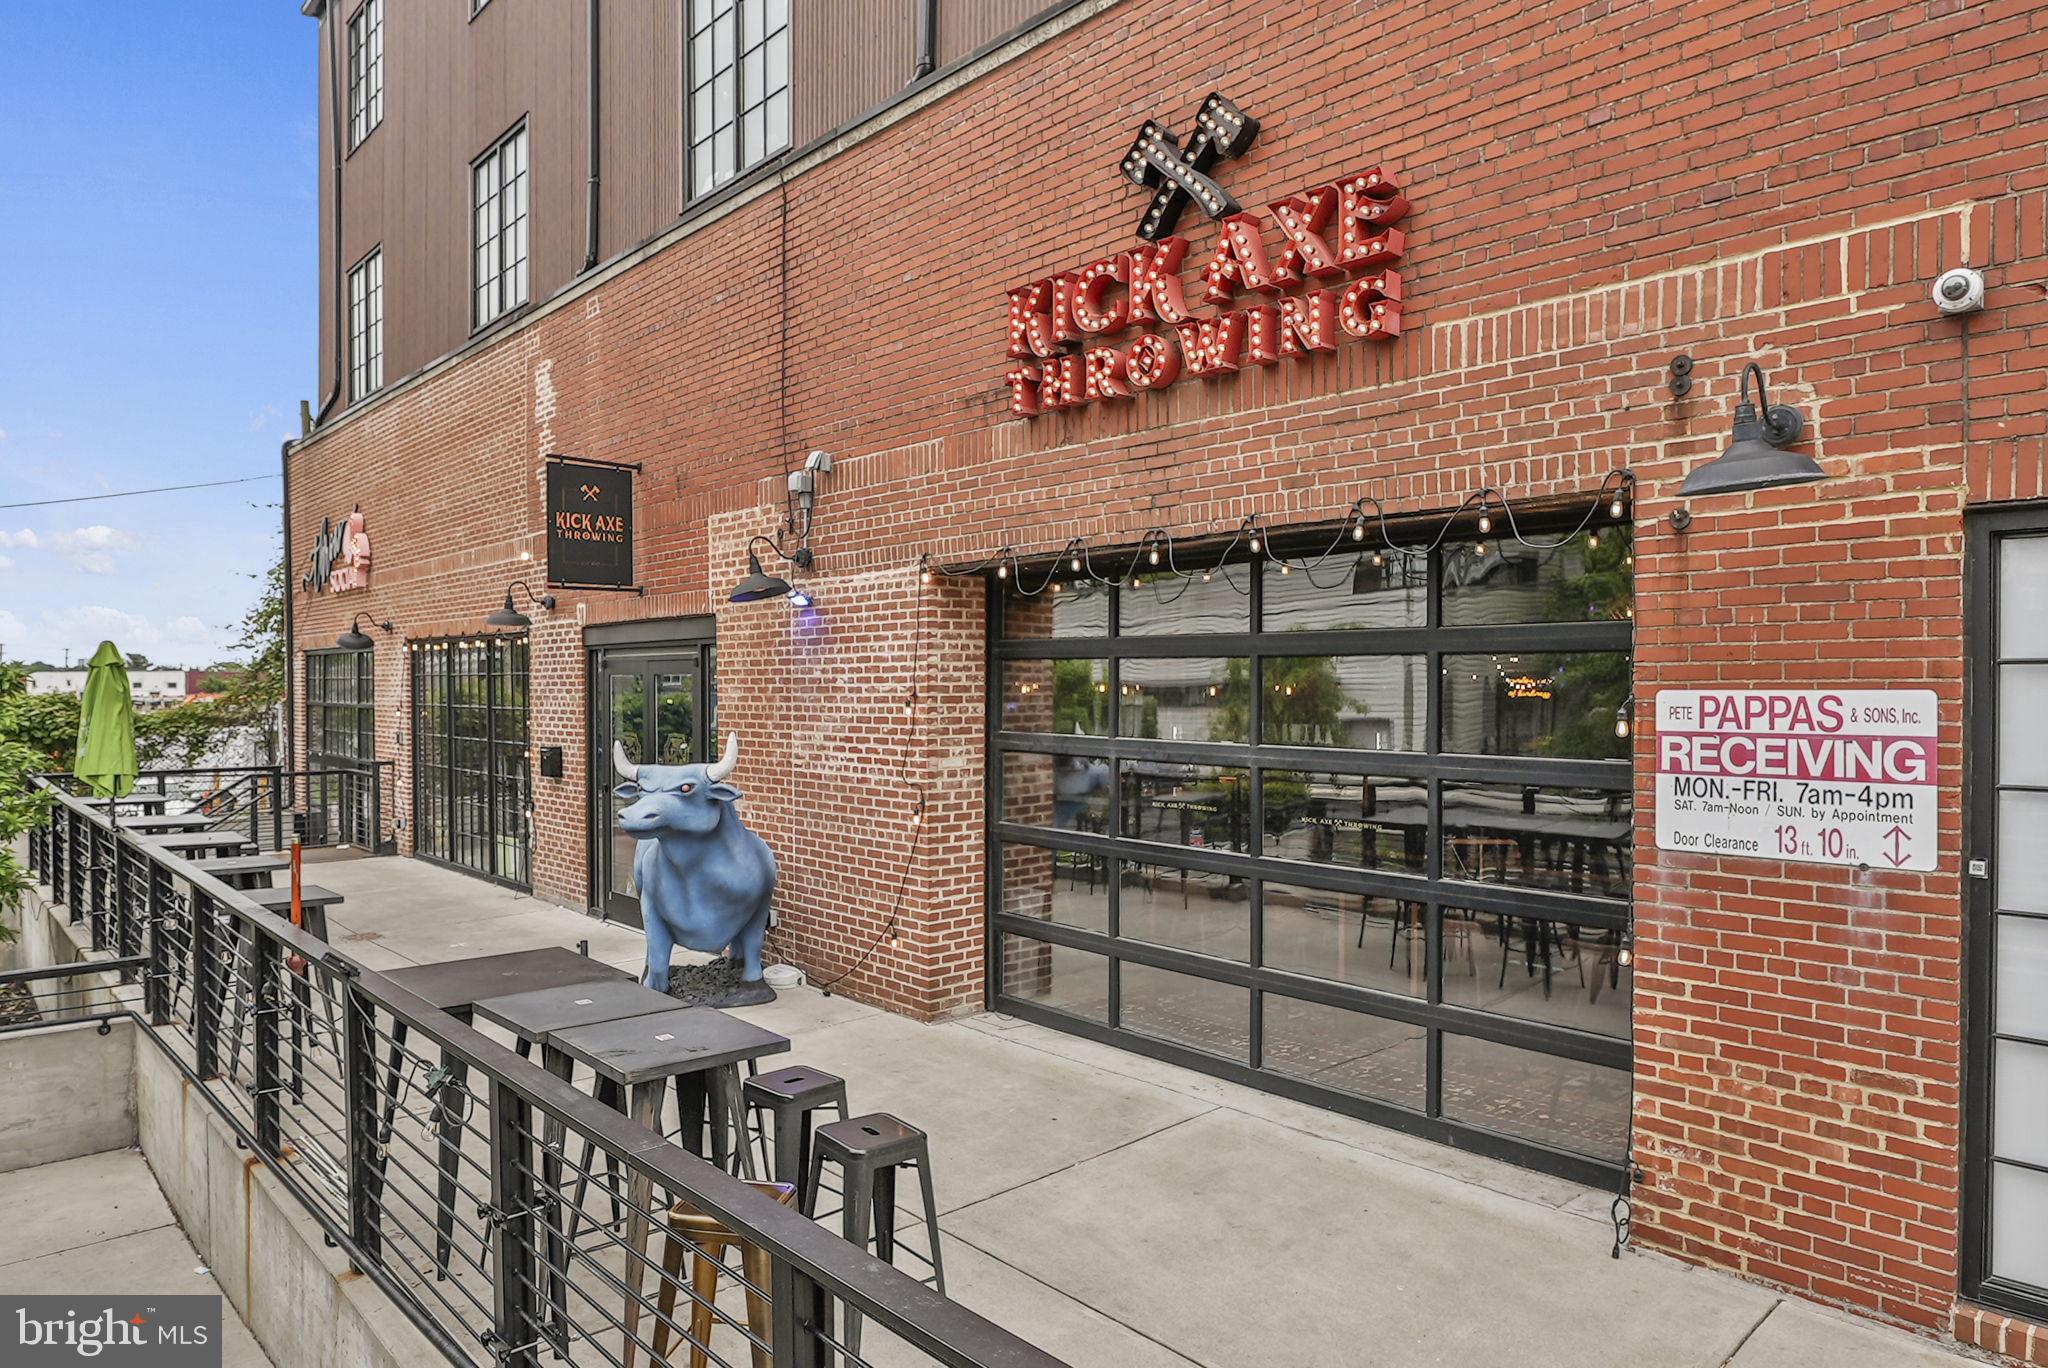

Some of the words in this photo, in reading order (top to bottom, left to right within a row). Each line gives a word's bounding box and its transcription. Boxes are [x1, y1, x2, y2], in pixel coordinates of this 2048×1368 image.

[1007, 236, 1200, 358] KICK
[1202, 166, 1411, 304] AXE
[1005, 269, 1402, 418] THROWING
[555, 512, 592, 532] KICK
[596, 515, 624, 532] AXE
[556, 529, 624, 543] THROWING
[1669, 706, 1692, 720] PETE
[1699, 695, 1844, 733] PAPPAS
[1850, 708, 1858, 722] &
[1660, 735, 1926, 782] RECEIVING
[1186, 804, 1218, 812] THROWING
[1674, 777, 1783, 802] MON.-FRI.
[1797, 782, 1914, 810] 7am-4pm
[1344, 821, 1383, 830] THROWING
[1674, 801, 1697, 812] SAT.
[1702, 801, 1759, 815] 7am-Noon
[1777, 805, 1805, 818] SUN.
[1811, 808, 1825, 822] by
[1832, 810, 1913, 824] Appointment
[1673, 831, 1698, 846] Door
[1704, 833, 1758, 852] Clearance
[1774, 825, 1798, 855] 13
[1801, 840, 1813, 856] ft.
[1817, 828, 1843, 858] 10
[1846, 844, 1859, 860] in.
